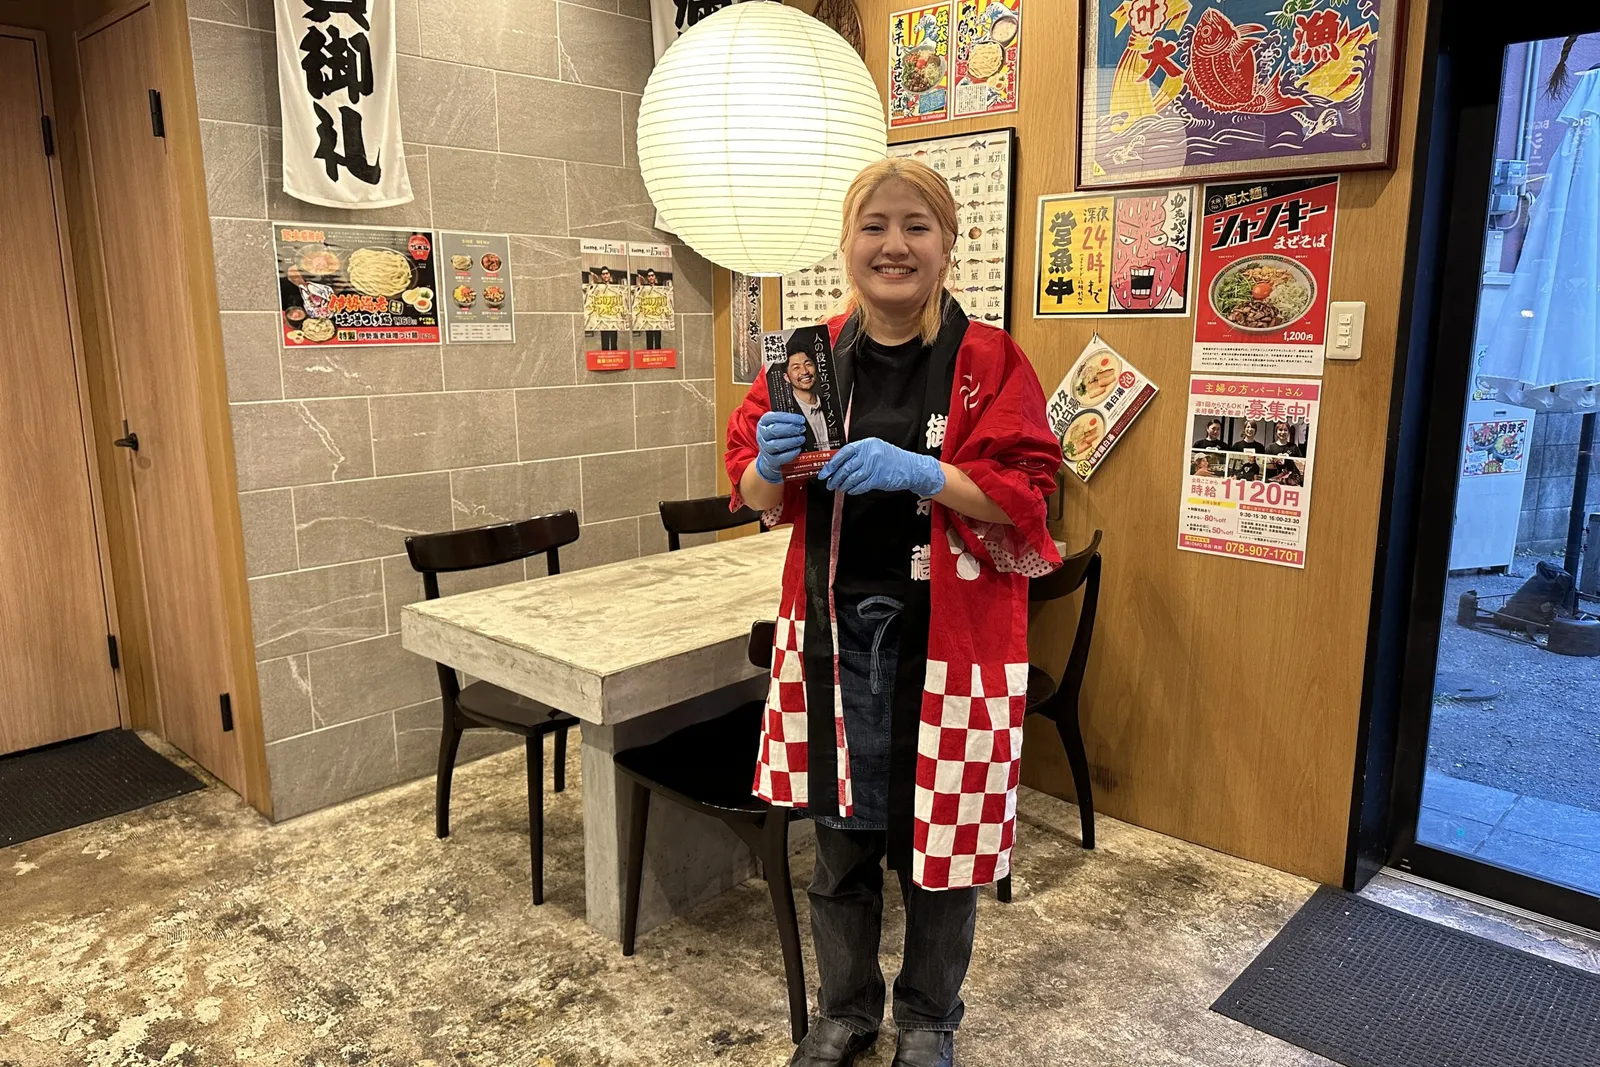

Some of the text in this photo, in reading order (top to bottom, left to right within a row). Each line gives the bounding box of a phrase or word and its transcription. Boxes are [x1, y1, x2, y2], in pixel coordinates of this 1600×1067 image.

[1136, 10, 1340, 82] 大 漁
[893, 18, 905, 110] 煮干しまぜそば
[1224, 186, 1262, 207] 極太麺
[1083, 206, 1110, 223] 深夜
[1210, 198, 1328, 251] ジャンキー
[1273, 234, 1328, 249] まぜそば
[328, 294, 388, 312] 伊勢海老
[339, 331, 356, 340] 特製
[1283, 331, 1314, 341] 1,200円
[1103, 387, 1126, 412] 鶏白湯
[1053, 397, 1081, 437] 鶏白湯
[1246, 399, 1311, 423] 募集中!
[1191, 479, 1299, 507] 時給 1120円
[1225, 542, 1299, 562] 078-907-1701
